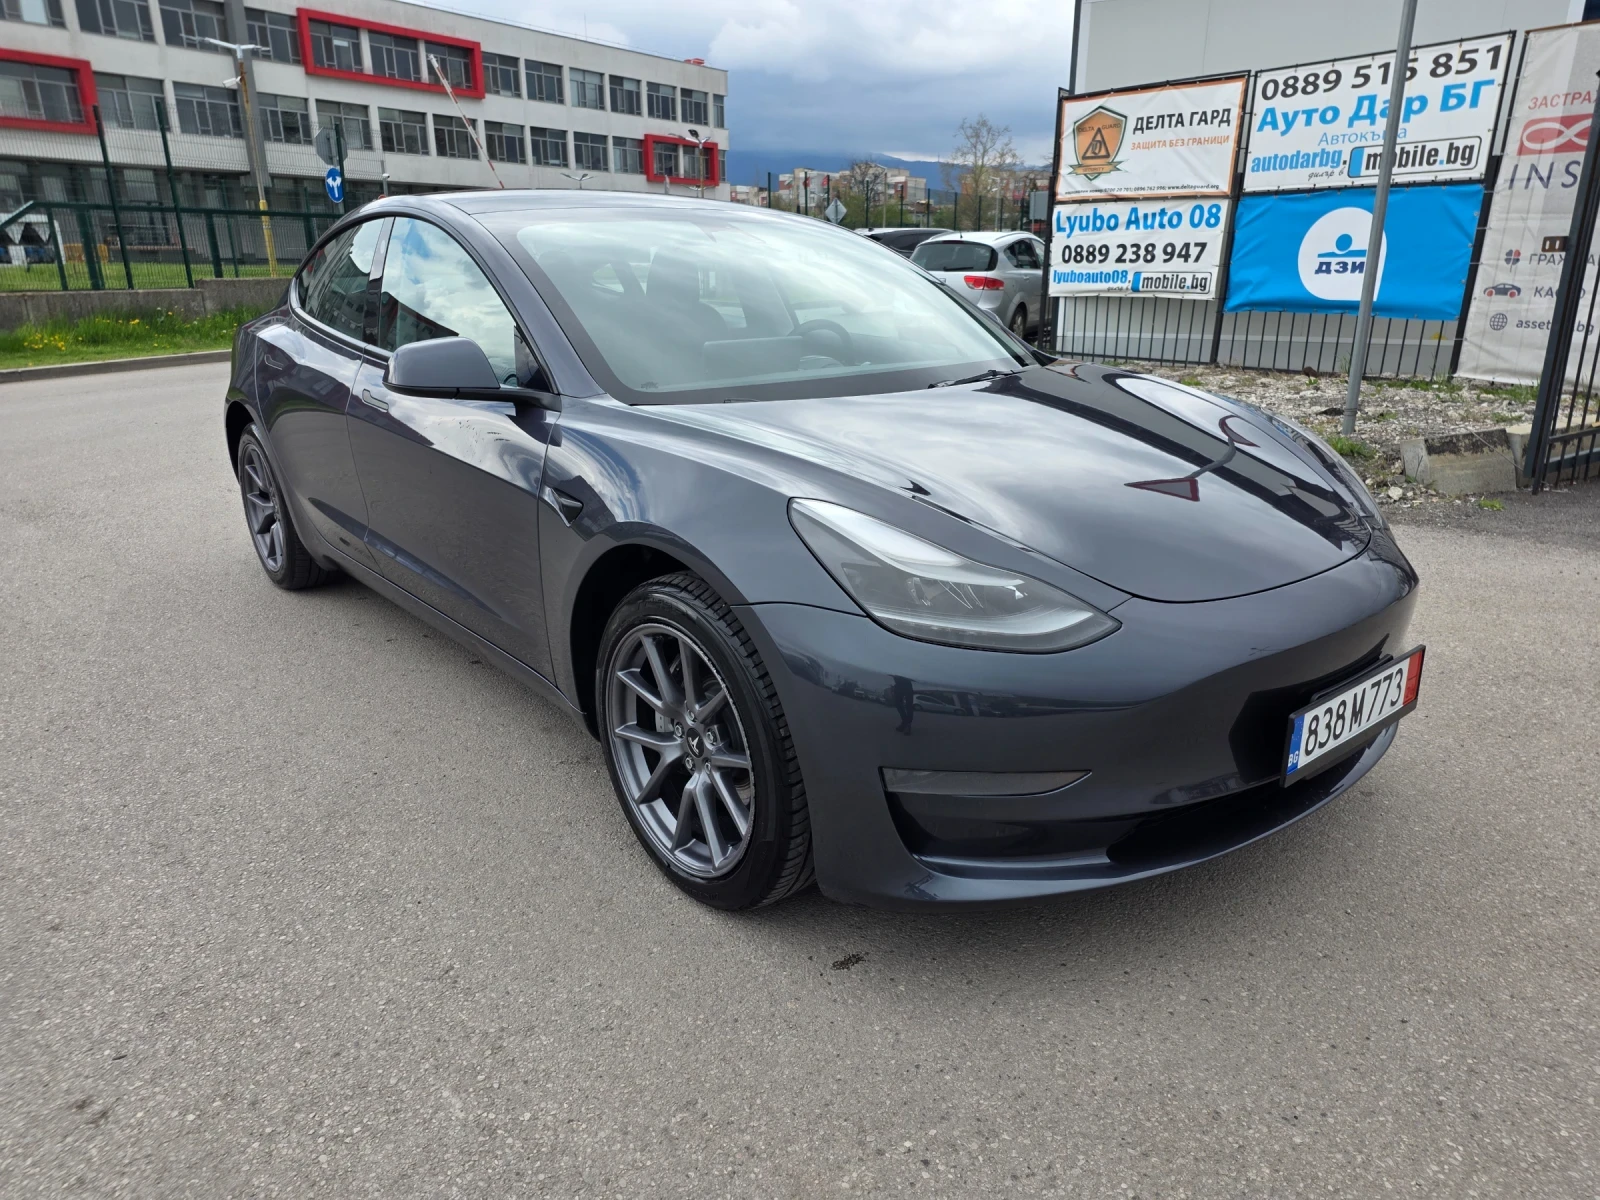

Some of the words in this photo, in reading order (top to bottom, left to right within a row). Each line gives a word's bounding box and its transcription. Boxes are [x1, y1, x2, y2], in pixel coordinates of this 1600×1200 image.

[1262, 70, 1342, 100] 0889
[1351, 58, 1418, 88] 515
[1430, 44, 1502, 78] 851
[1256, 106, 1340, 136] Ауто
[1347, 94, 1428, 128] Дар
[1440, 79, 1495, 112] БГ
[1528, 91, 1597, 110] ЗАСТРА
[1132, 112, 1185, 134] ДЕЛТА
[1189, 108, 1232, 128] ГАРД
[1131, 140, 1168, 151] ЗАЩИТА
[1169, 138, 1185, 148] БЕЗ
[1186, 135, 1230, 146] ГРАНИЦИ
[1318, 128, 1408, 146] Автокъа
[1364, 142, 1475, 170] mbile.bg
[1056, 208, 1119, 239] Lyubo
[1124, 206, 1183, 230] Auto
[1189, 204, 1222, 229] 08
[1062, 244, 1110, 264] 0889
[1114, 243, 1156, 264] 238
[1162, 242, 1208, 264] 947
[1529, 254, 1596, 266] ГРАА
[1314, 261, 1366, 274] ДЗИ
[1142, 274, 1208, 291] mobile.bg
[1533, 286, 1586, 298] КАО
[1516, 320, 1594, 336] asset.bg
[1288, 751, 1299, 767] BG
